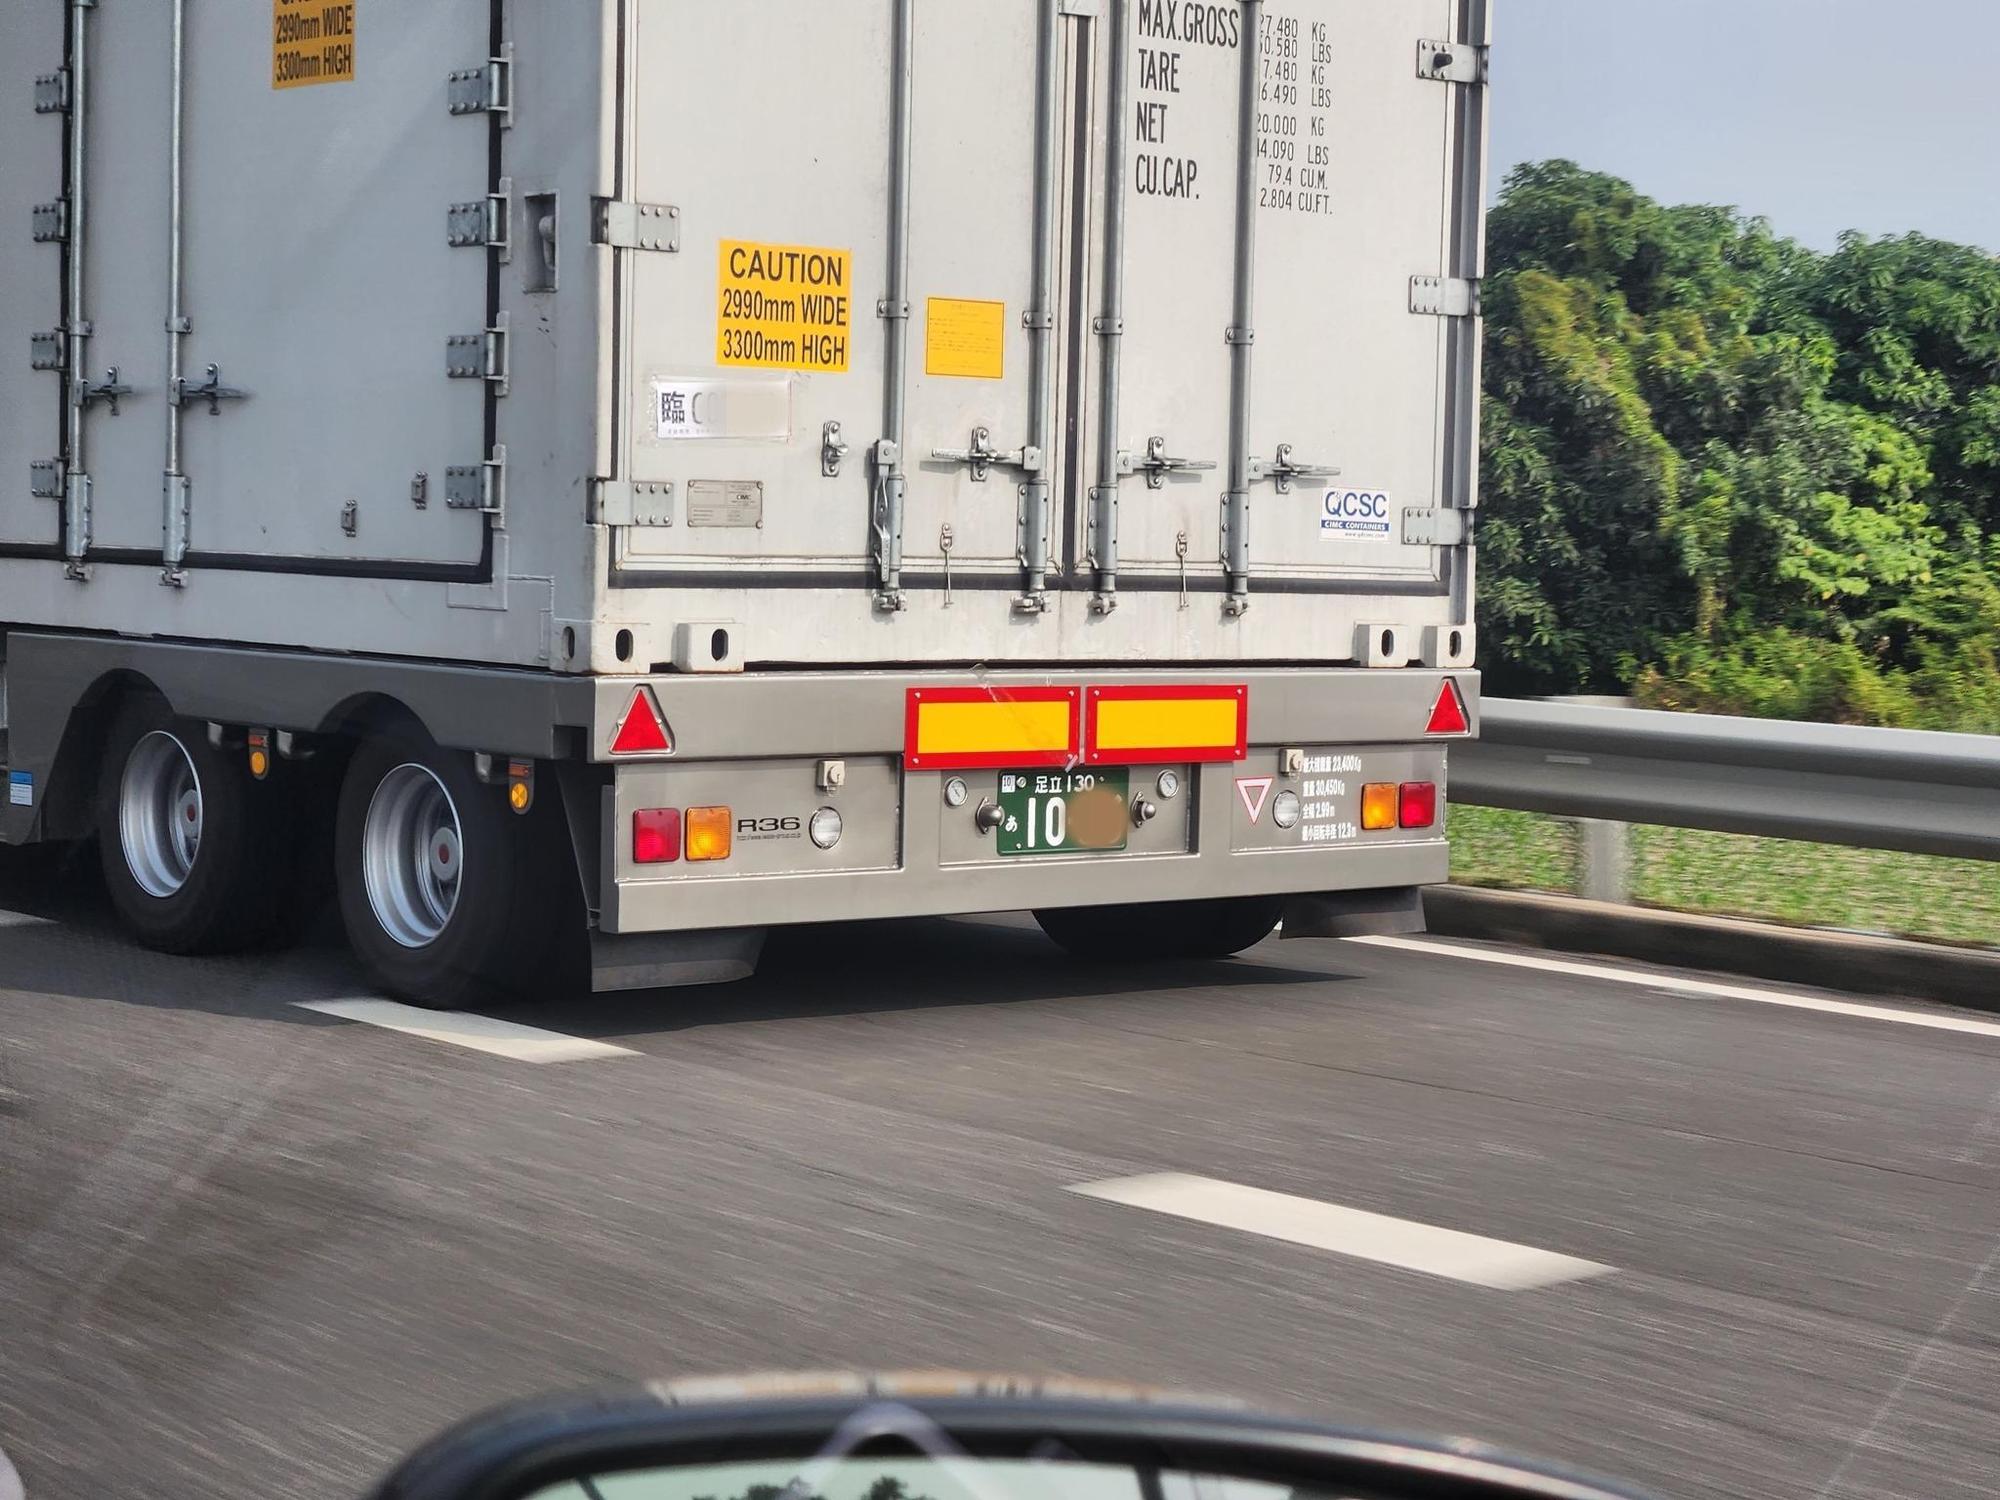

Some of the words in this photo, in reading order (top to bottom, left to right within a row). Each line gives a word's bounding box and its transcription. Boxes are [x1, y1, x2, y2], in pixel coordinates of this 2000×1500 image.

[276, 12, 320, 44] 2990mm
[322, 4, 352, 37] WIDE
[1138, 0, 1239, 49] MAX.GROSS
[1312, 22, 1326, 43] KG
[276, 50, 320, 82] 3300mm
[323, 43, 352, 76] HIGH
[1312, 43, 1332, 64] LBS
[1138, 49, 1181, 93] TARE
[1312, 64, 1325, 85] KG
[1311, 87, 1331, 108] LBS
[1136, 101, 1168, 143] NET
[1311, 116, 1325, 137] KG
[1308, 144, 1329, 166] LBS
[1135, 154, 1200, 200] CU.CAP.
[1269, 164, 1292, 186] 79.4
[1300, 168, 1328, 190] CU.M.
[1298, 192, 1333, 215] CU.FT.
[730, 248, 842, 287] CAUTION
[722, 288, 795, 323] 2990mm
[801, 293, 847, 327] WIDE
[723, 328, 795, 363] 3300mm
[801, 333, 845, 366] HIGH
[1325, 491, 1387, 518] QCSC
[1325, 521, 1343, 529] CIMC
[1346, 521, 1385, 530] CONTAINERS
[1066, 775, 1095, 793] 130
[737, 816, 801, 833] R36
[1005, 815, 1018, 832] あ
